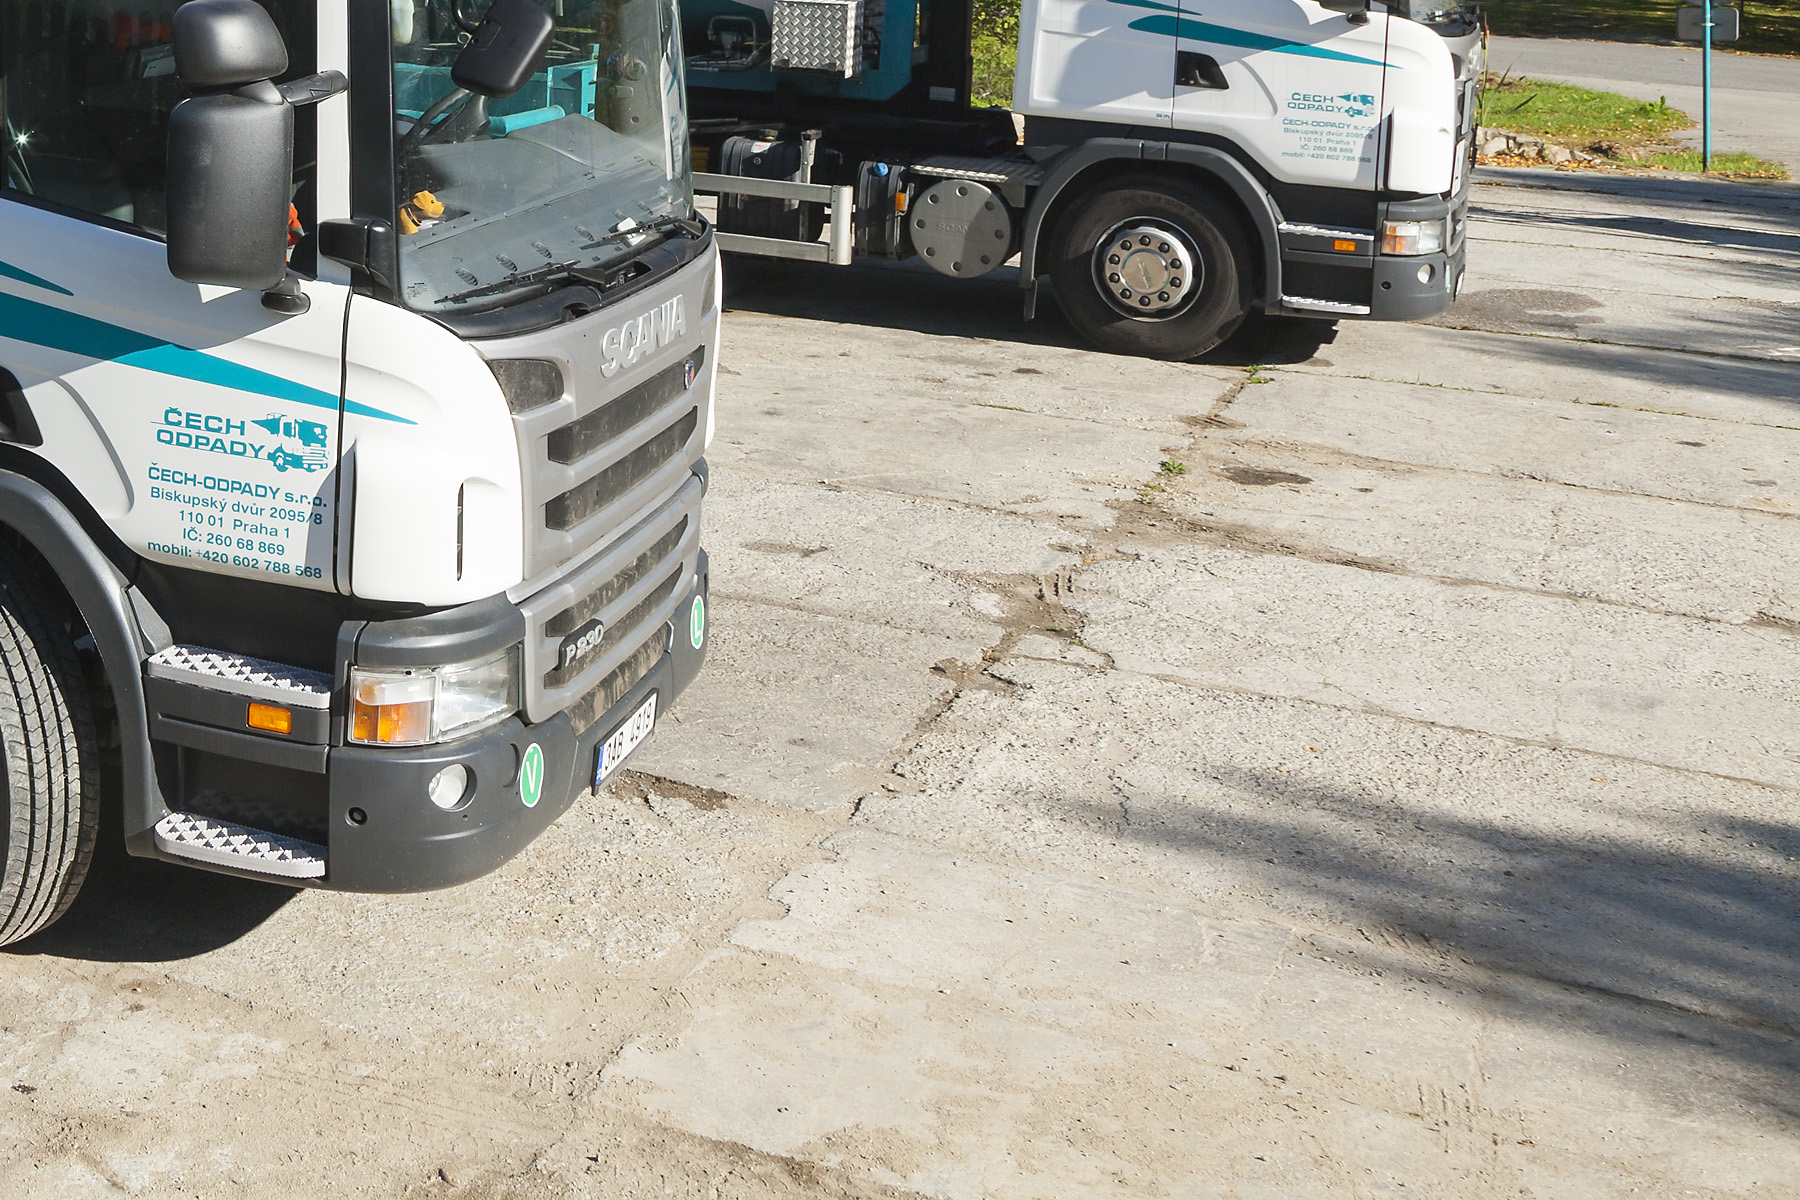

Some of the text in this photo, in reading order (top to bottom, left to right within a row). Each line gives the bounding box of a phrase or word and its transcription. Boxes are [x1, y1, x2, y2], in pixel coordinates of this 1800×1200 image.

[1282, 117, 1352, 129] ČECH-ODPADY
[1287, 102, 1344, 113] ODPADY
[599, 293, 687, 378] SCANIA
[163, 406, 246, 436] ČECH
[156, 428, 266, 458] ODPADY
[148, 462, 328, 508] ČECH-ODPADY s.r.o.
[150, 487, 323, 525] Biskupský dvůr 2095/8
[179, 509, 290, 539] 110 01 Praha 1
[147, 541, 322, 579] mobil: +420 602 788 568
[183, 526, 285, 556] IČ: 260 68 869
[564, 623, 605, 667] P230
[603, 704, 653, 771] 3AB 4919
[525, 752, 538, 794] V
